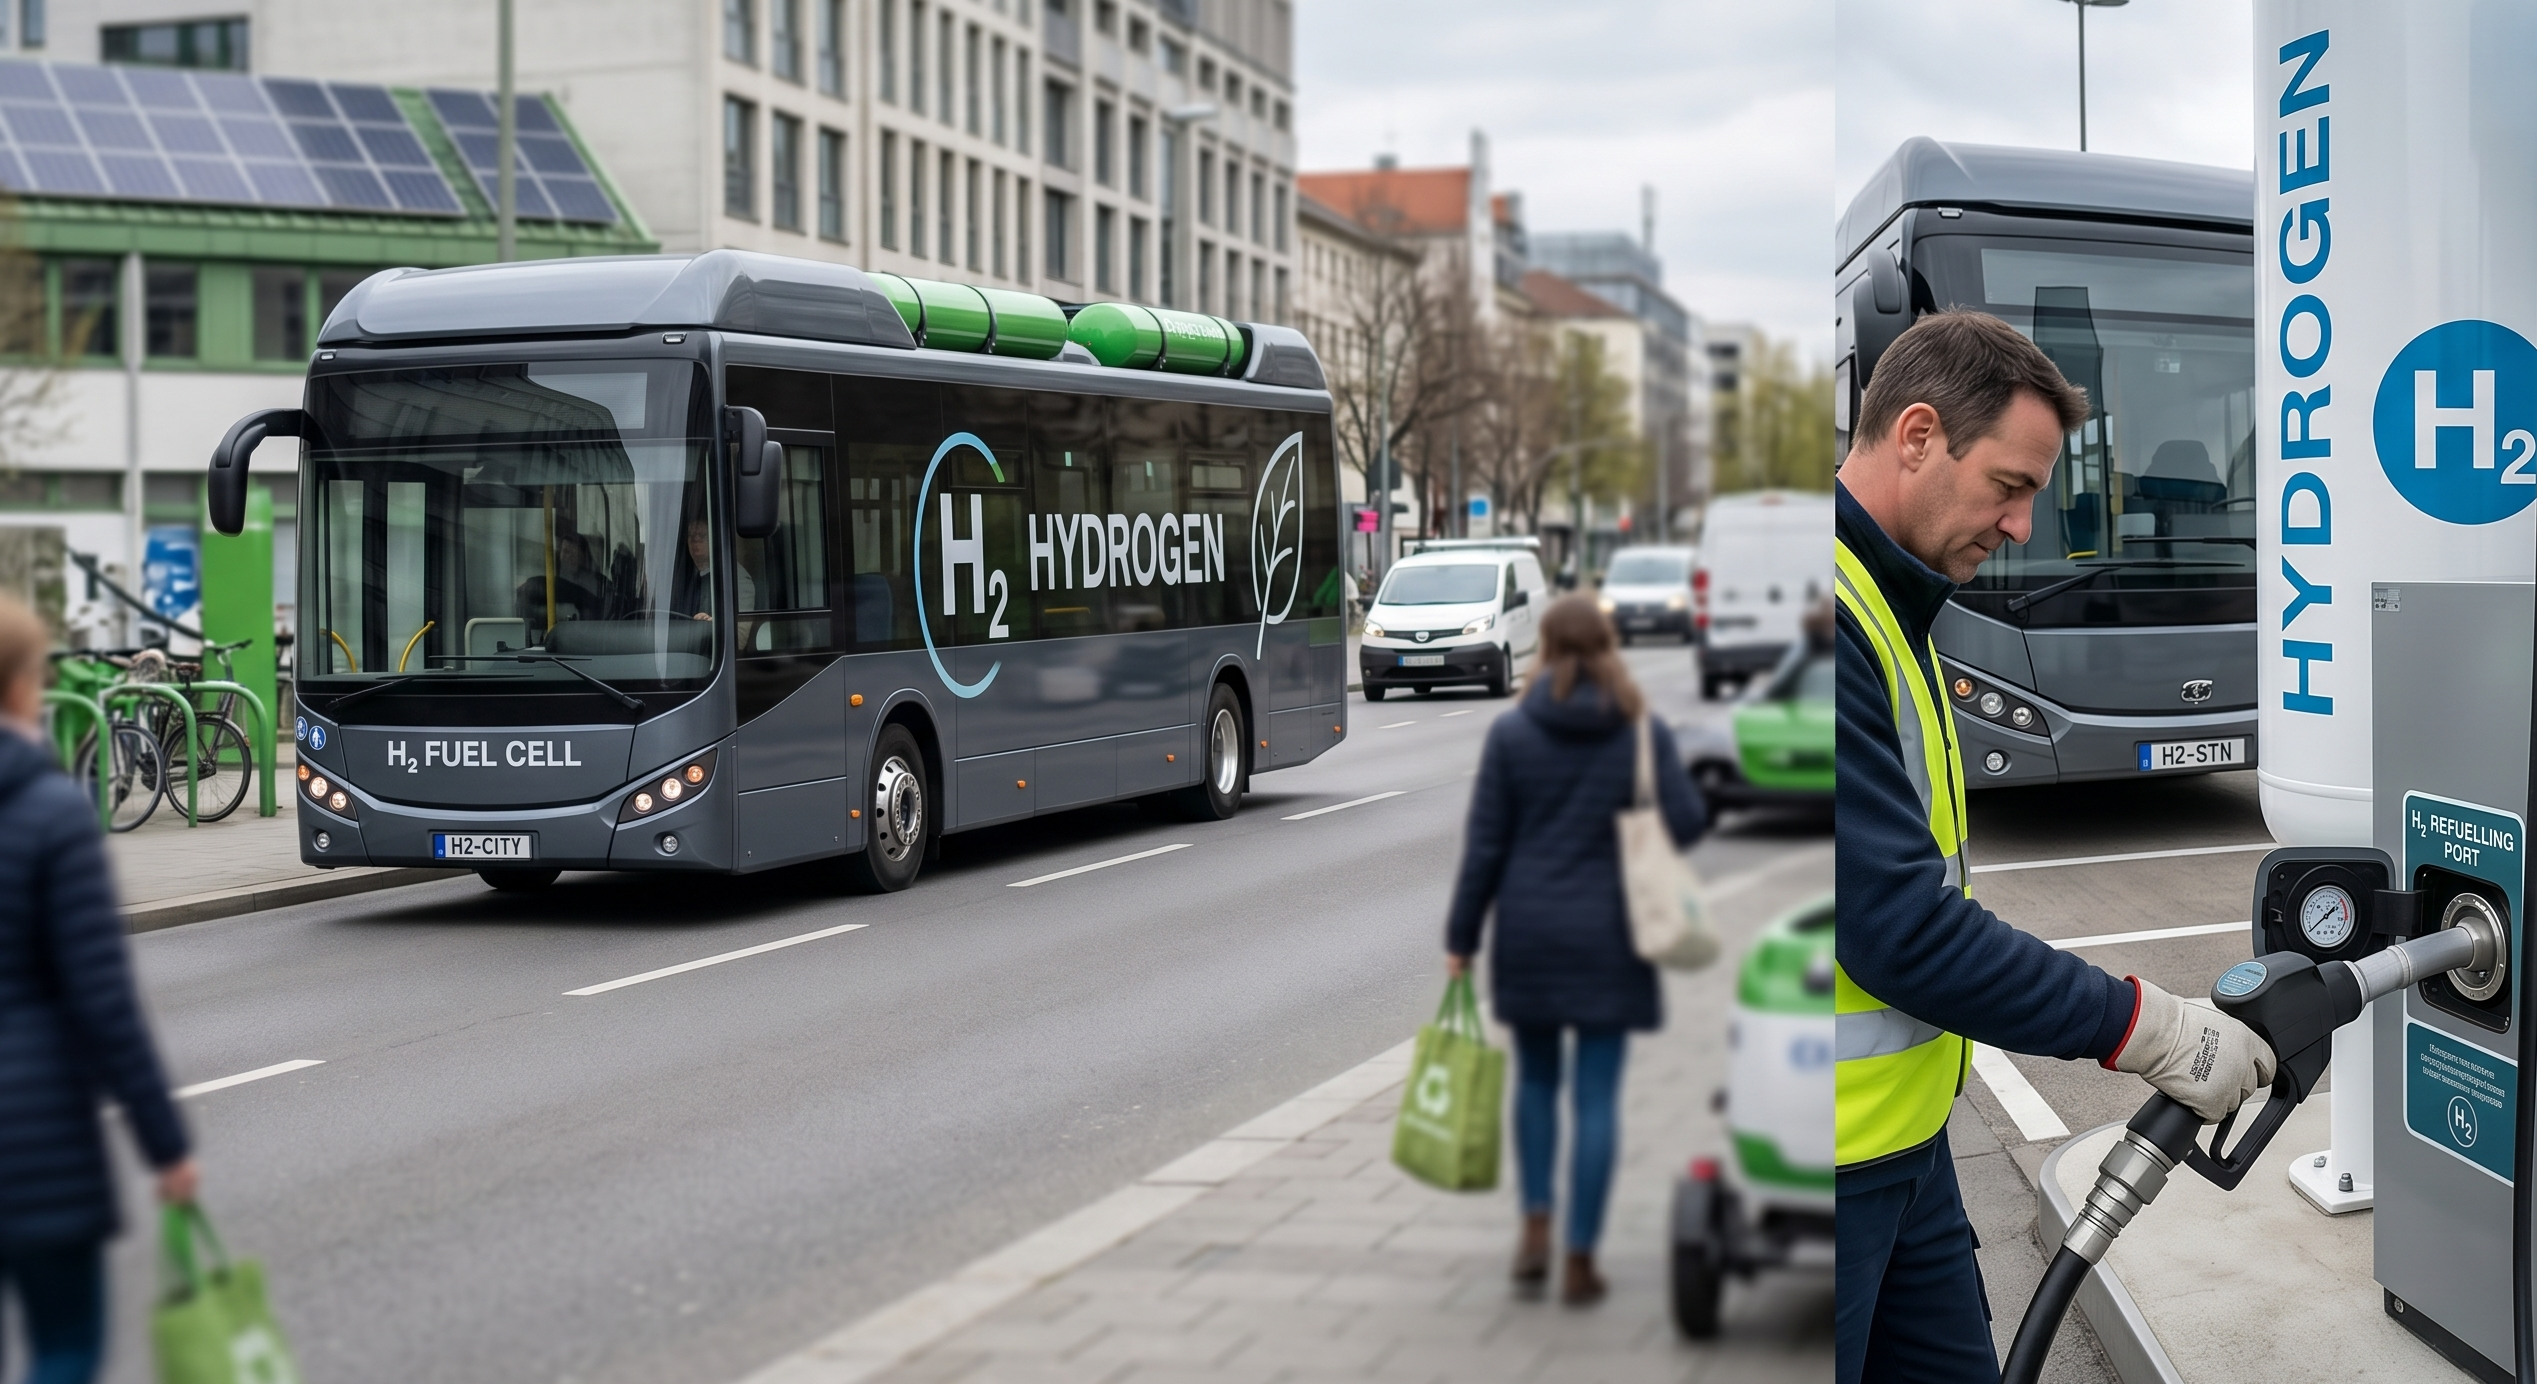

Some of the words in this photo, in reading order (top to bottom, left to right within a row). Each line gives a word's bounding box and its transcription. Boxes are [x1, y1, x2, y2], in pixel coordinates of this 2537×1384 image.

[2278, 27, 2334, 716] HYDROGEN
[2414, 369, 2537, 485] H2
[940, 493, 1010, 638] H2
[1028, 512, 1225, 591] HYDROGEN
[387, 740, 418, 773] H2
[424, 740, 498, 767] FUEL
[505, 740, 582, 767] CELL
[2162, 741, 2232, 766] H2-STN
[450, 837, 522, 856] H2-CITY
[2411, 809, 2427, 838] H2
[2430, 814, 2514, 852] REFUELLING
[2444, 841, 2480, 867] PORT
[2454, 1105, 2473, 1140] H2
